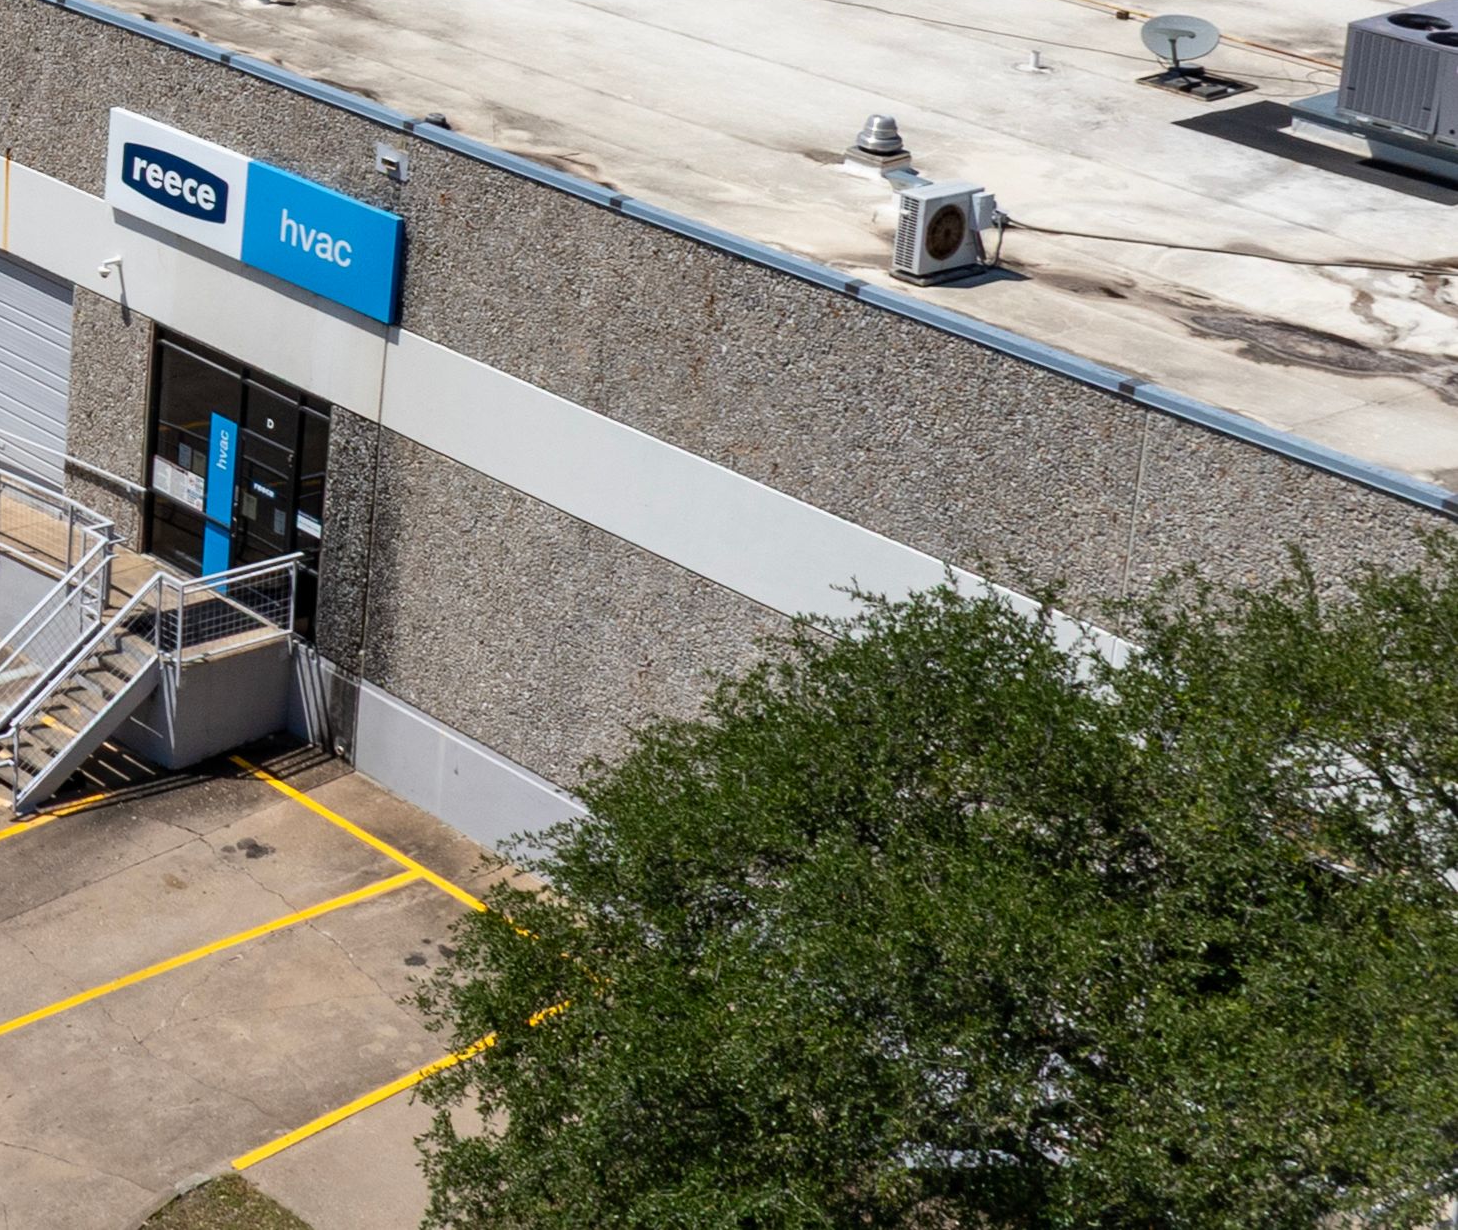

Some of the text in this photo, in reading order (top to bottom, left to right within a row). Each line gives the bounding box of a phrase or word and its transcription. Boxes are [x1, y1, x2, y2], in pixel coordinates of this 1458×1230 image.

[132, 155, 352, 267] reece hvac
[267, 418, 275, 429] D
[216, 430, 229, 470] hvac
